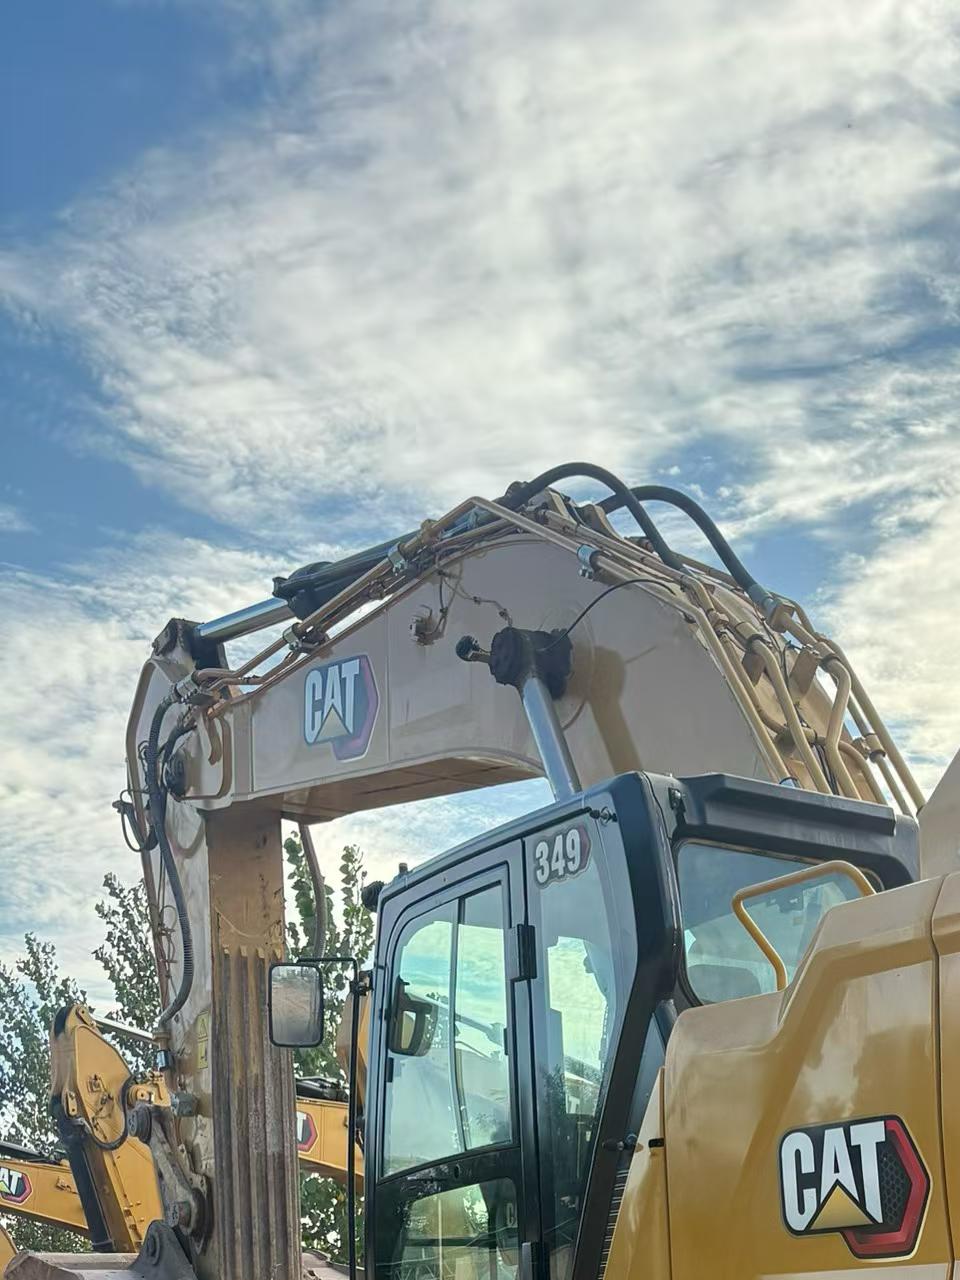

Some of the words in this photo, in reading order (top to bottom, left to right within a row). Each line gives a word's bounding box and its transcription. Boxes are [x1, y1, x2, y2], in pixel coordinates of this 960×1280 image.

[304, 658, 361, 745] CAT
[535, 828, 581, 884] 349
[0, 1166, 23, 1196] AT
[781, 1120, 886, 1231] CAT
